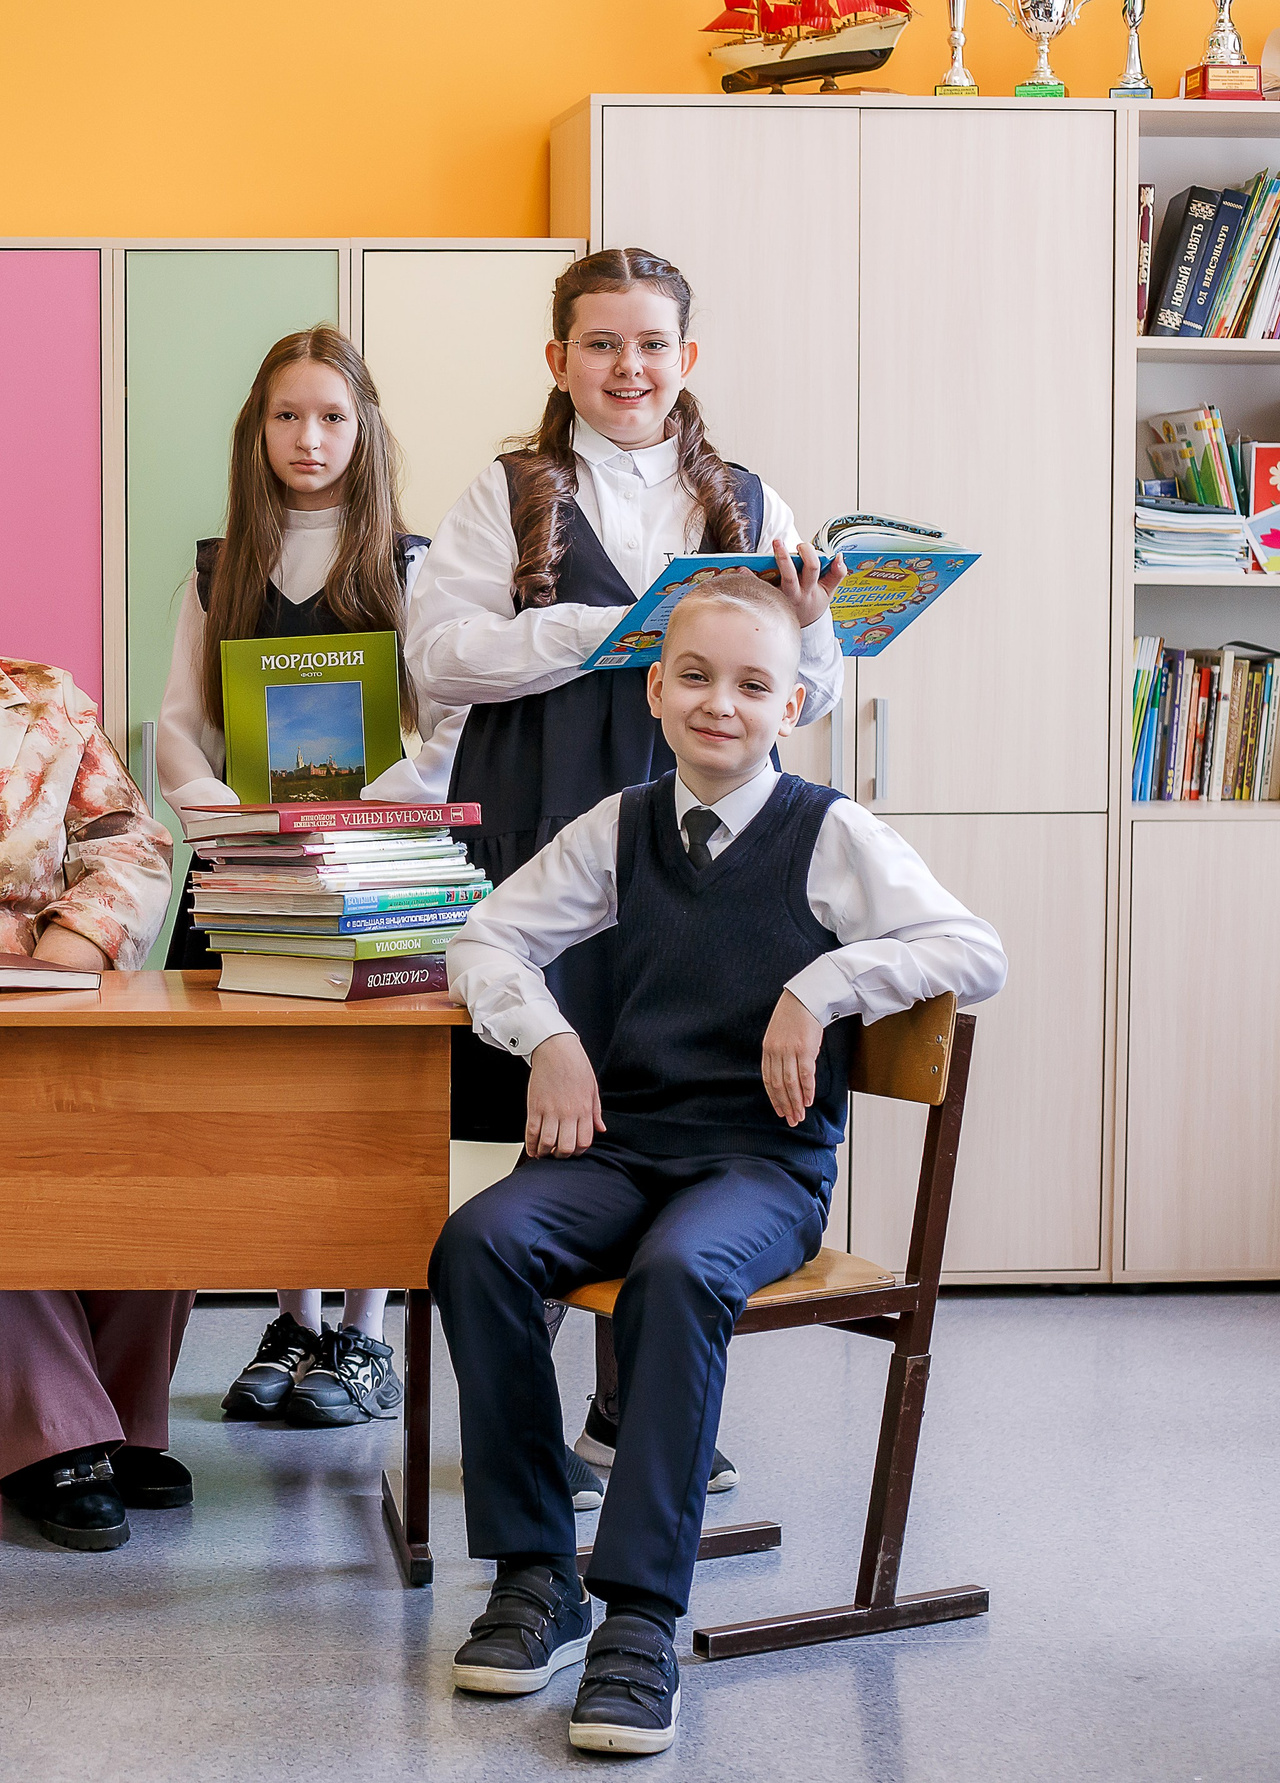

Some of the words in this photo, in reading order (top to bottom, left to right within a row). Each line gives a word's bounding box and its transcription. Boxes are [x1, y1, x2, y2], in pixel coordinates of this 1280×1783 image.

[1171, 265, 1192, 308] НОВЫЙ
[261, 650, 365, 671] МОРДОВИЯ
[300, 814, 337, 822] МОРДОВИЯ
[340, 811, 384, 825] КНИГА
[385, 809, 443, 823] КРАСНАЯ
[352, 918, 385, 928] БОЛЬШАЯ
[375, 938, 421, 952] MORDOVIA
